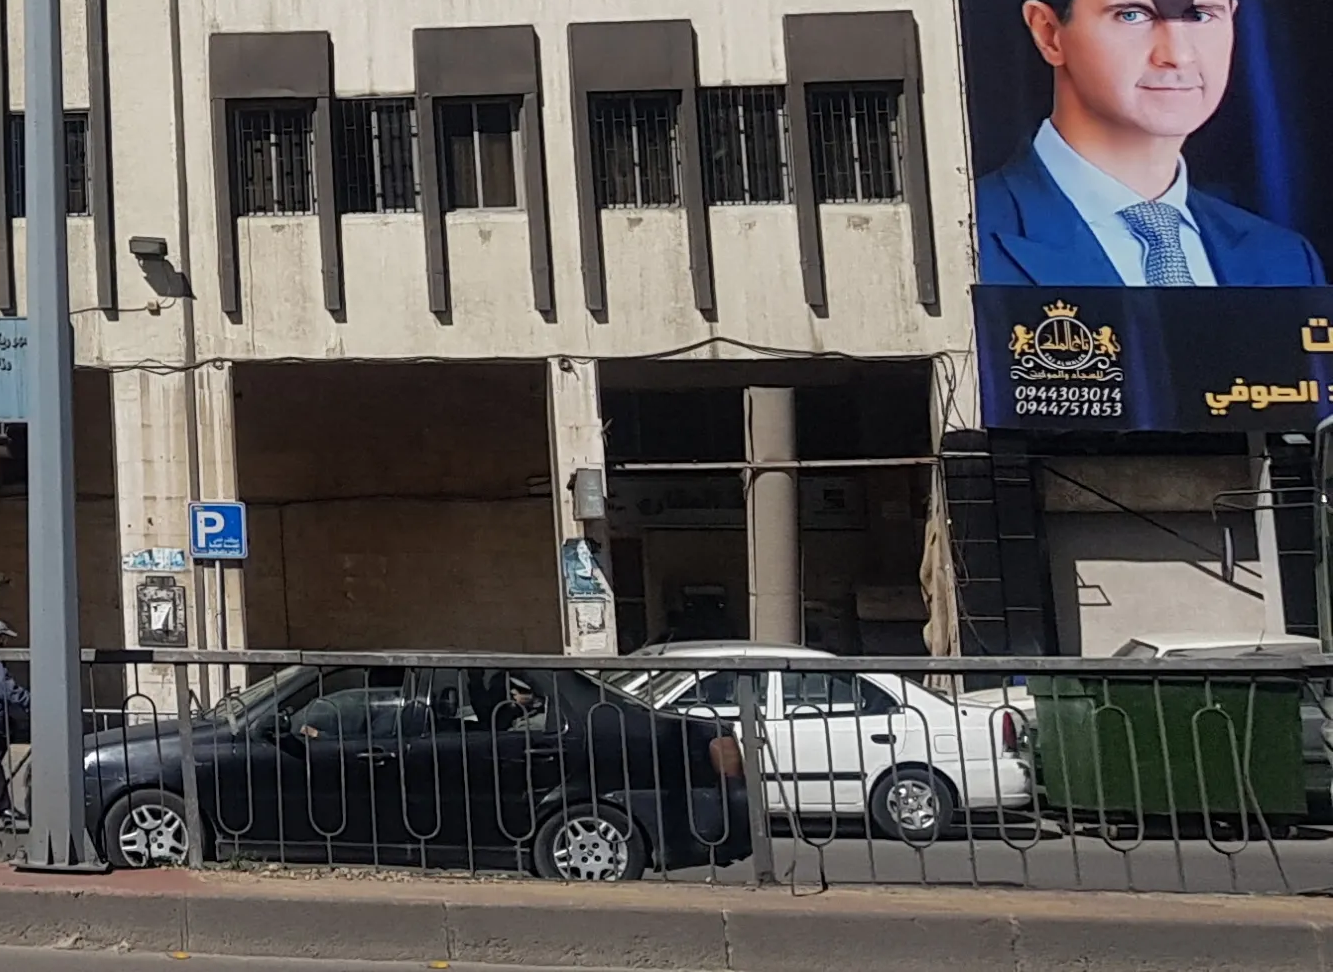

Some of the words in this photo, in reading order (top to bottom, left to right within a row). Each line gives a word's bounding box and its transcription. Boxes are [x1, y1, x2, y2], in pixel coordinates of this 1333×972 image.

[1014, 385, 1122, 402] 0944303014
[1204, 377, 1320, 416] الصوفي
[1015, 400, 1123, 416] 0944751853
[196, 511, 225, 548] P
